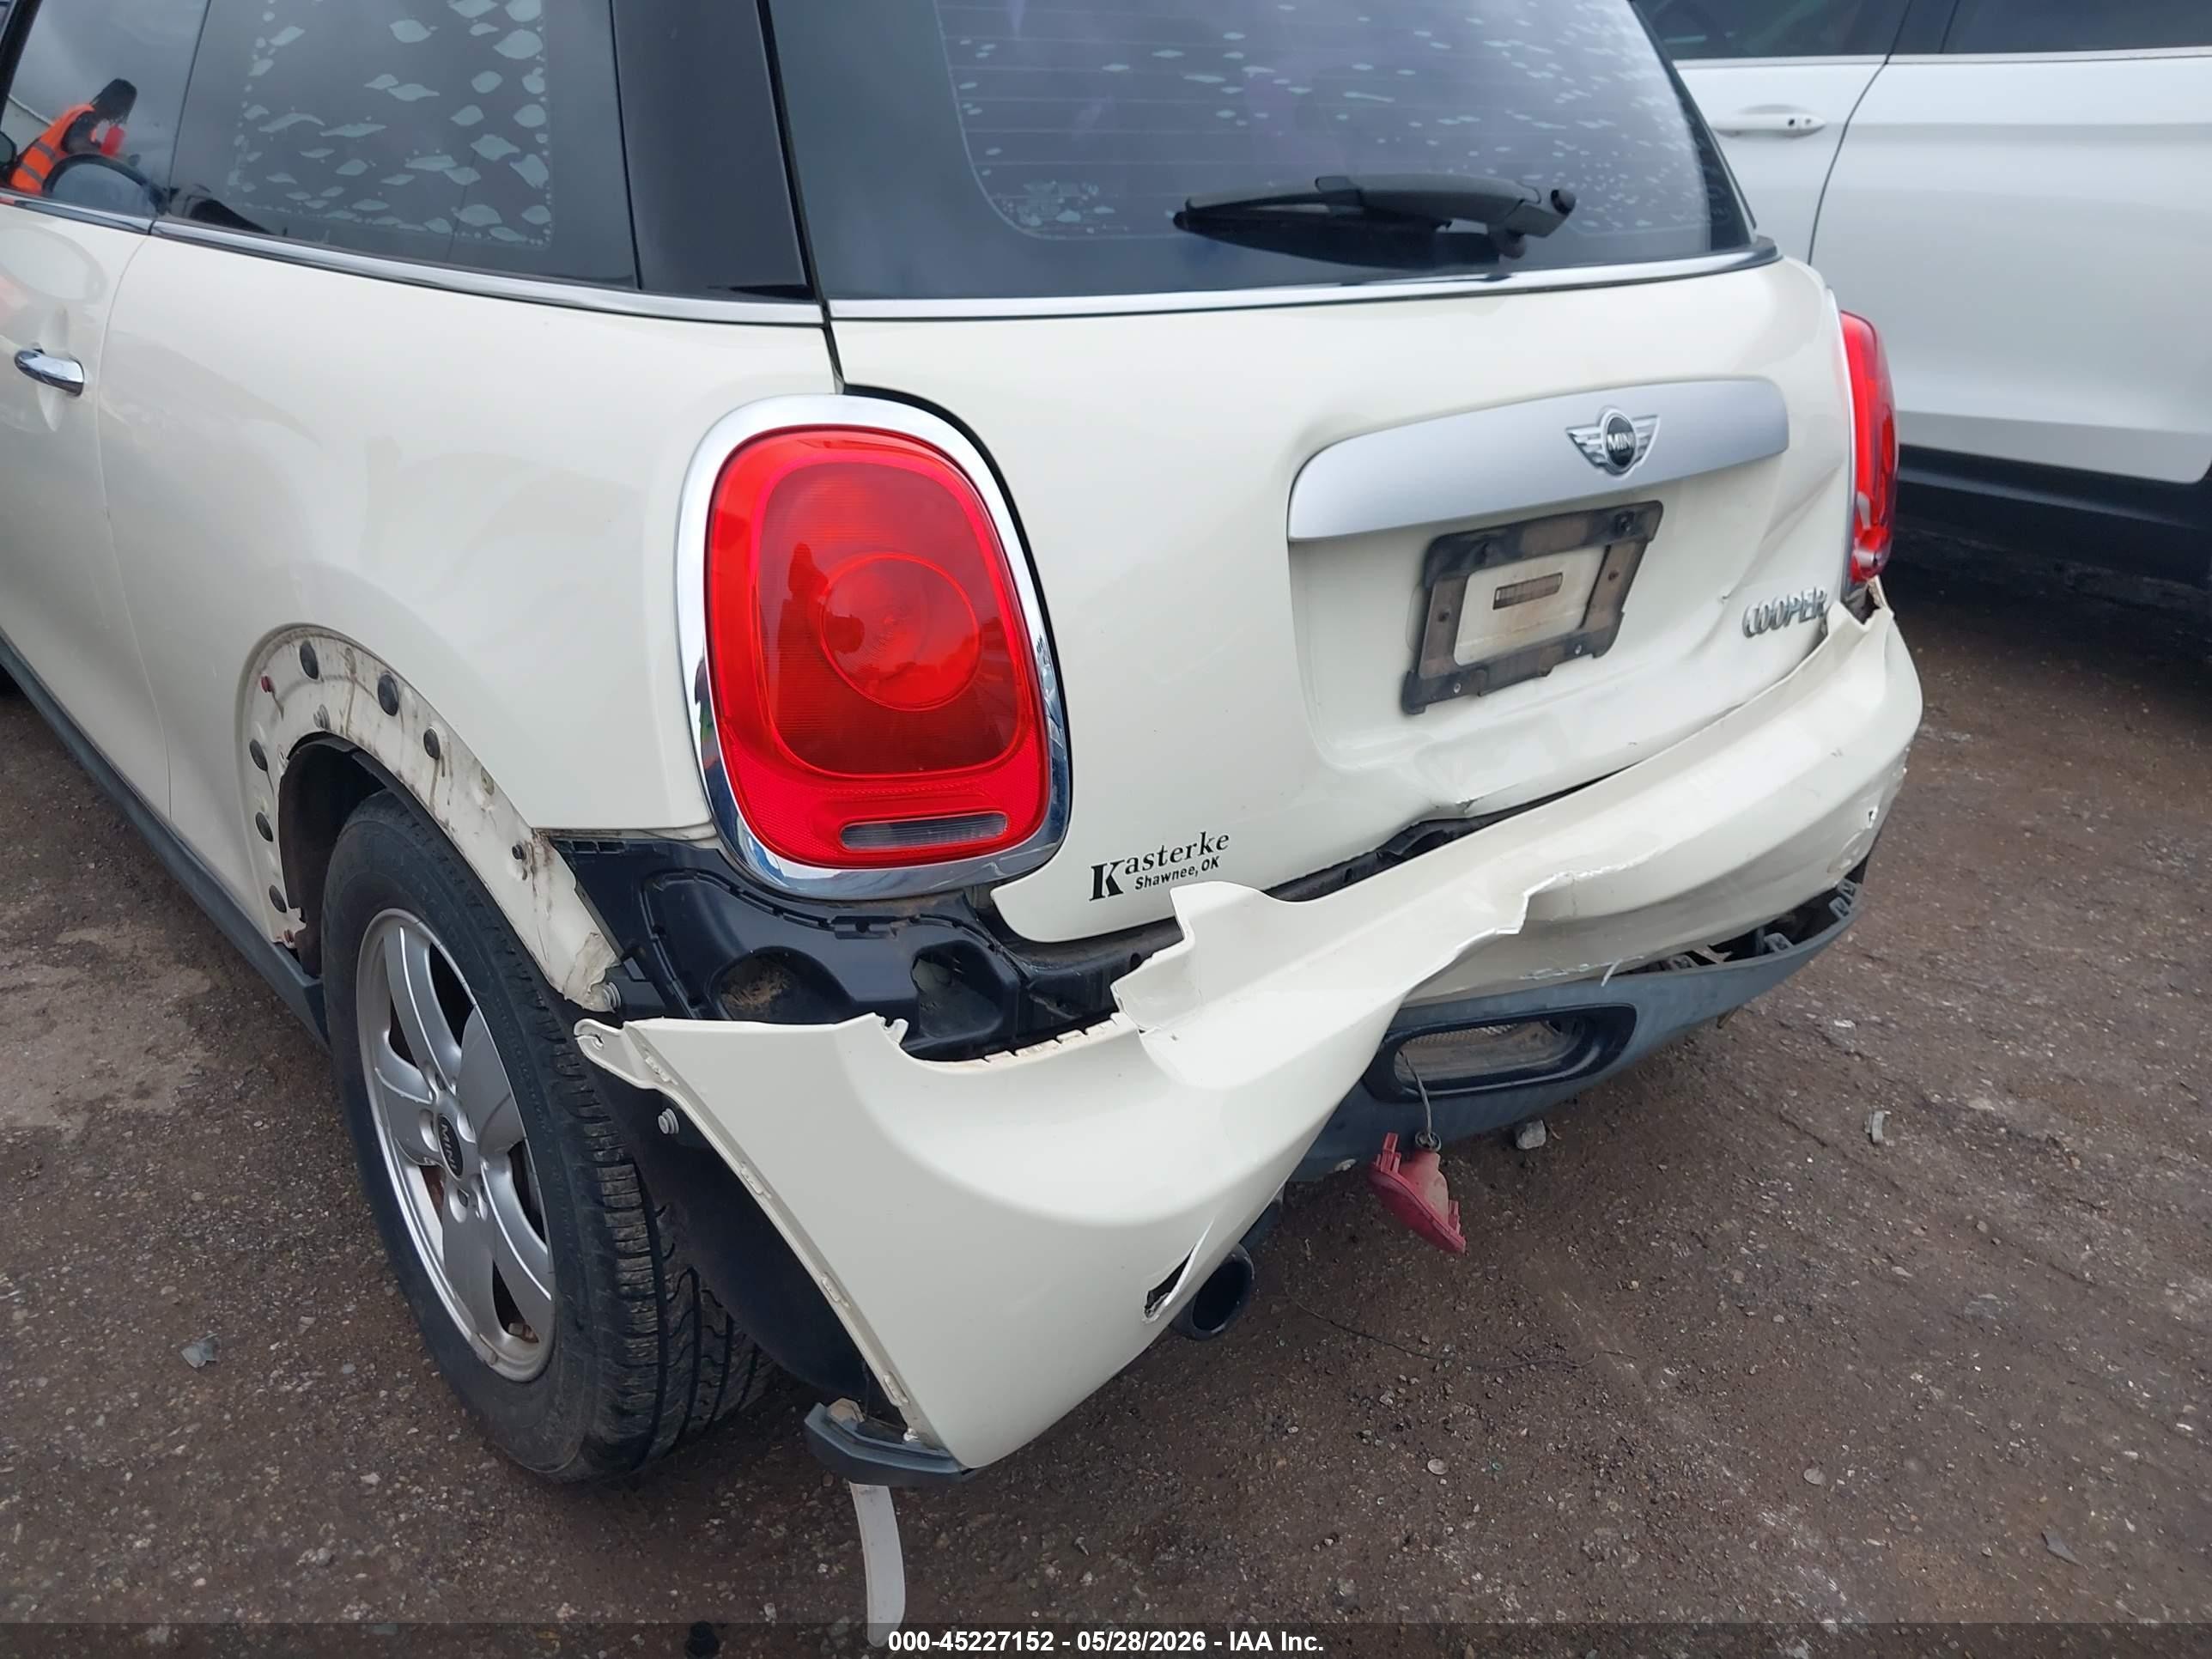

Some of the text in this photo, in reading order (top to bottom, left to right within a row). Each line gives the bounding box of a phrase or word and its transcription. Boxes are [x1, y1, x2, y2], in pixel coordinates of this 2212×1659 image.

[1607, 431, 1635, 451] MINI
[1742, 588, 1827, 638] COOPER
[1089, 831, 1229, 901] Kasterke
[1134, 856, 1220, 890] Shawnee, OK
[441, 1123, 457, 1169] MINI
